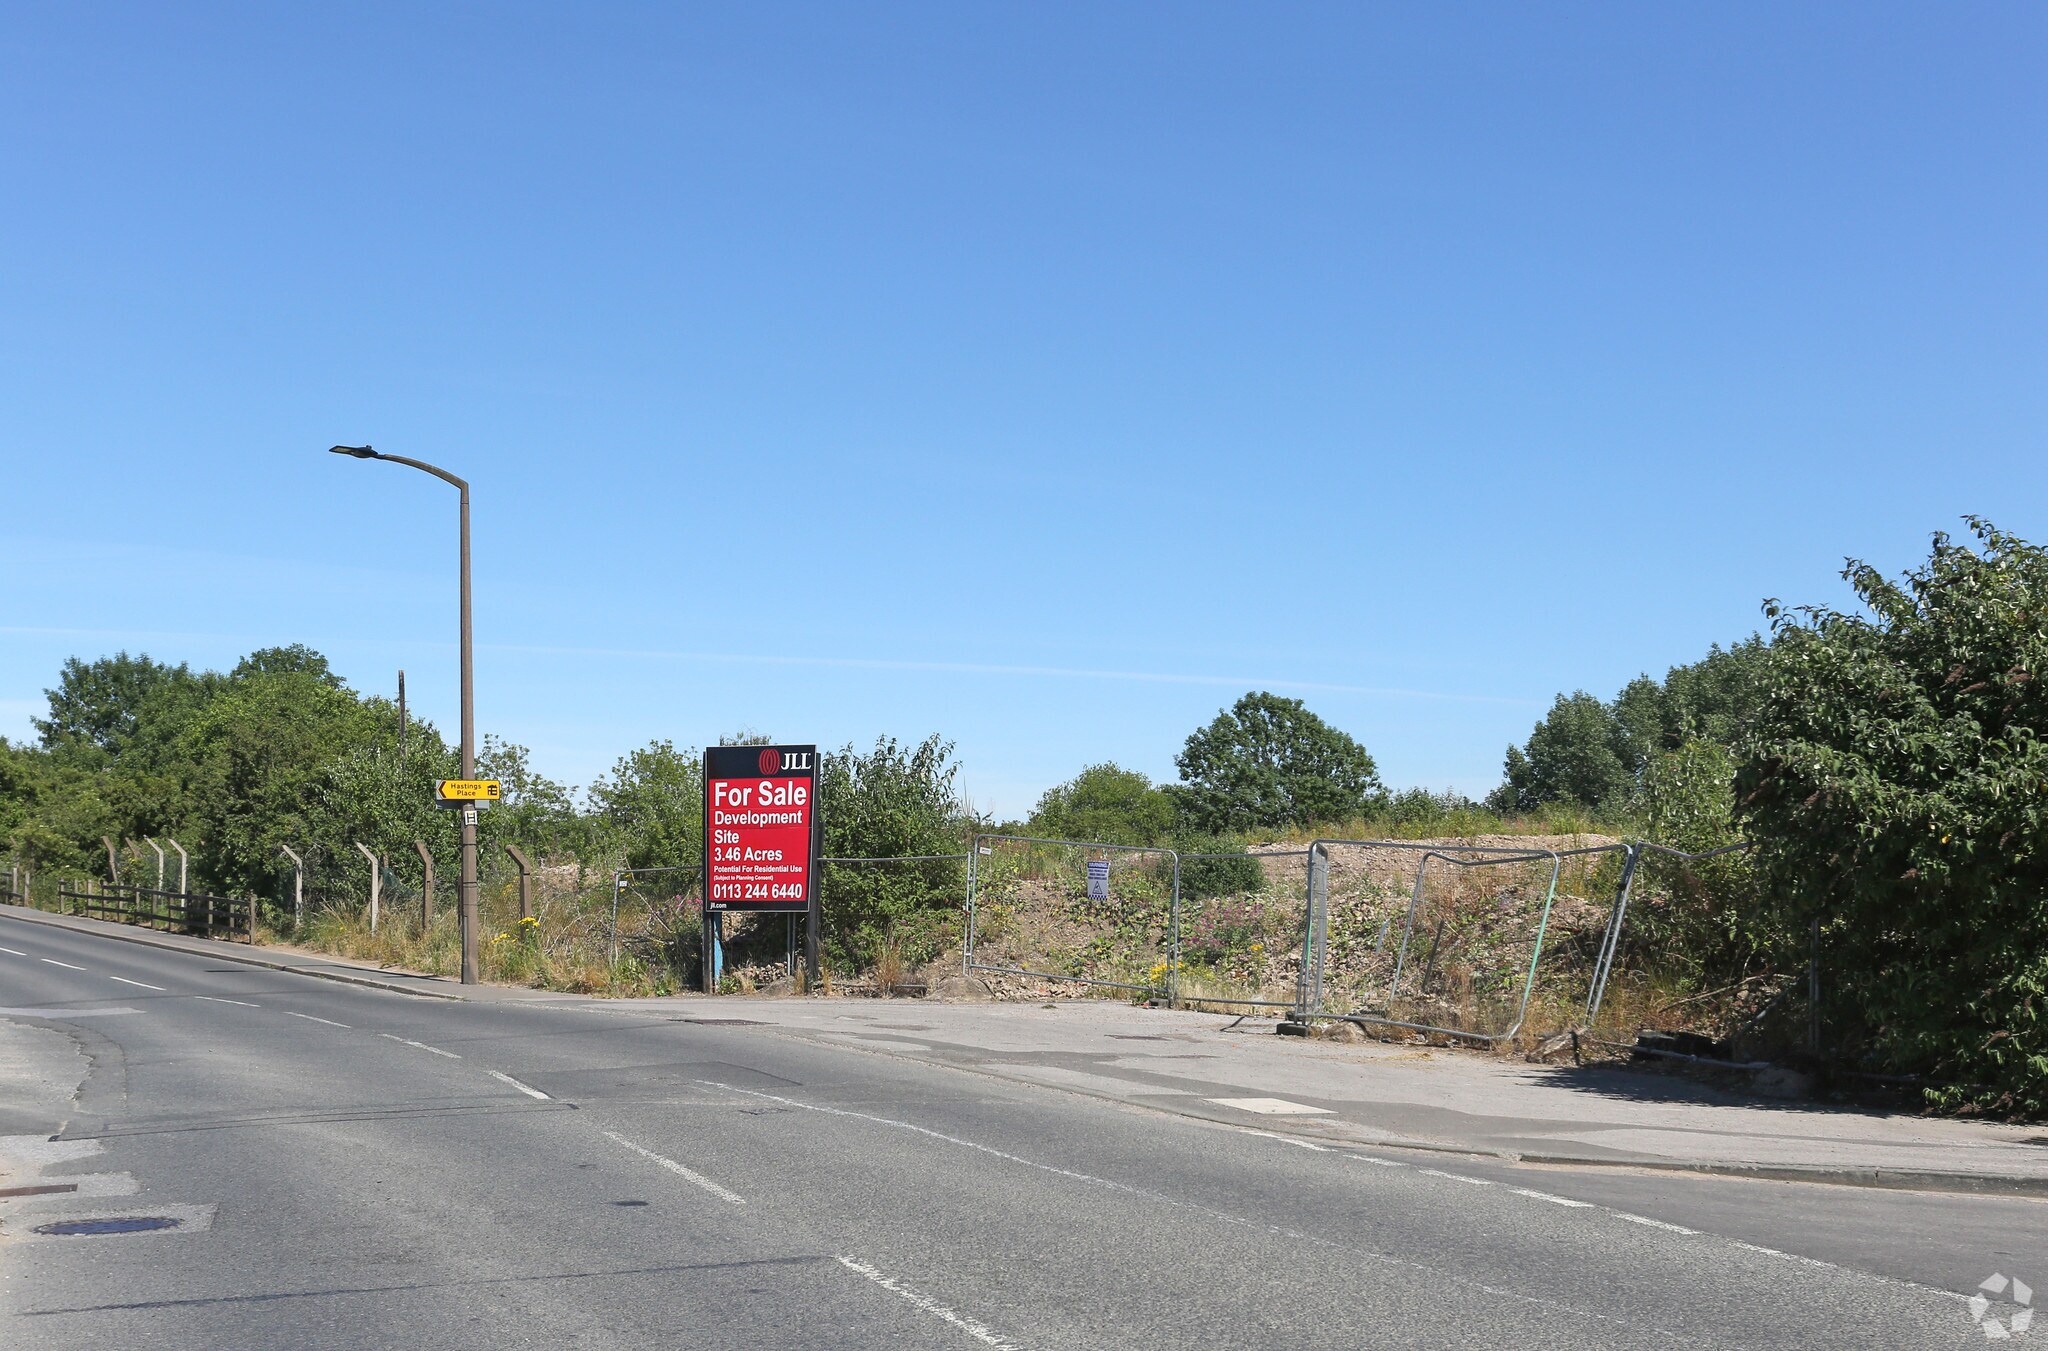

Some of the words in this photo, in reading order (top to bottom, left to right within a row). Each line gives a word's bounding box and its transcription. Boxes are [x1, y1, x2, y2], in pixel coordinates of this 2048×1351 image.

[781, 753, 811, 770] JLL
[715, 782, 752, 806] For
[758, 781, 807, 806] Sale
[715, 810, 802, 828] Development
[714, 829, 740, 844] Site
[714, 847, 741, 861] 3.46
[744, 847, 783, 861] Acres
[714, 865, 741, 873] Potential
[742, 865, 753, 873] For
[754, 865, 789, 873] Residential
[790, 865, 802, 873] Use
[714, 884, 741, 898] 0113
[745, 884, 768, 898] 244
[771, 884, 802, 898] 6440
[710, 902, 727, 910] jll.com
